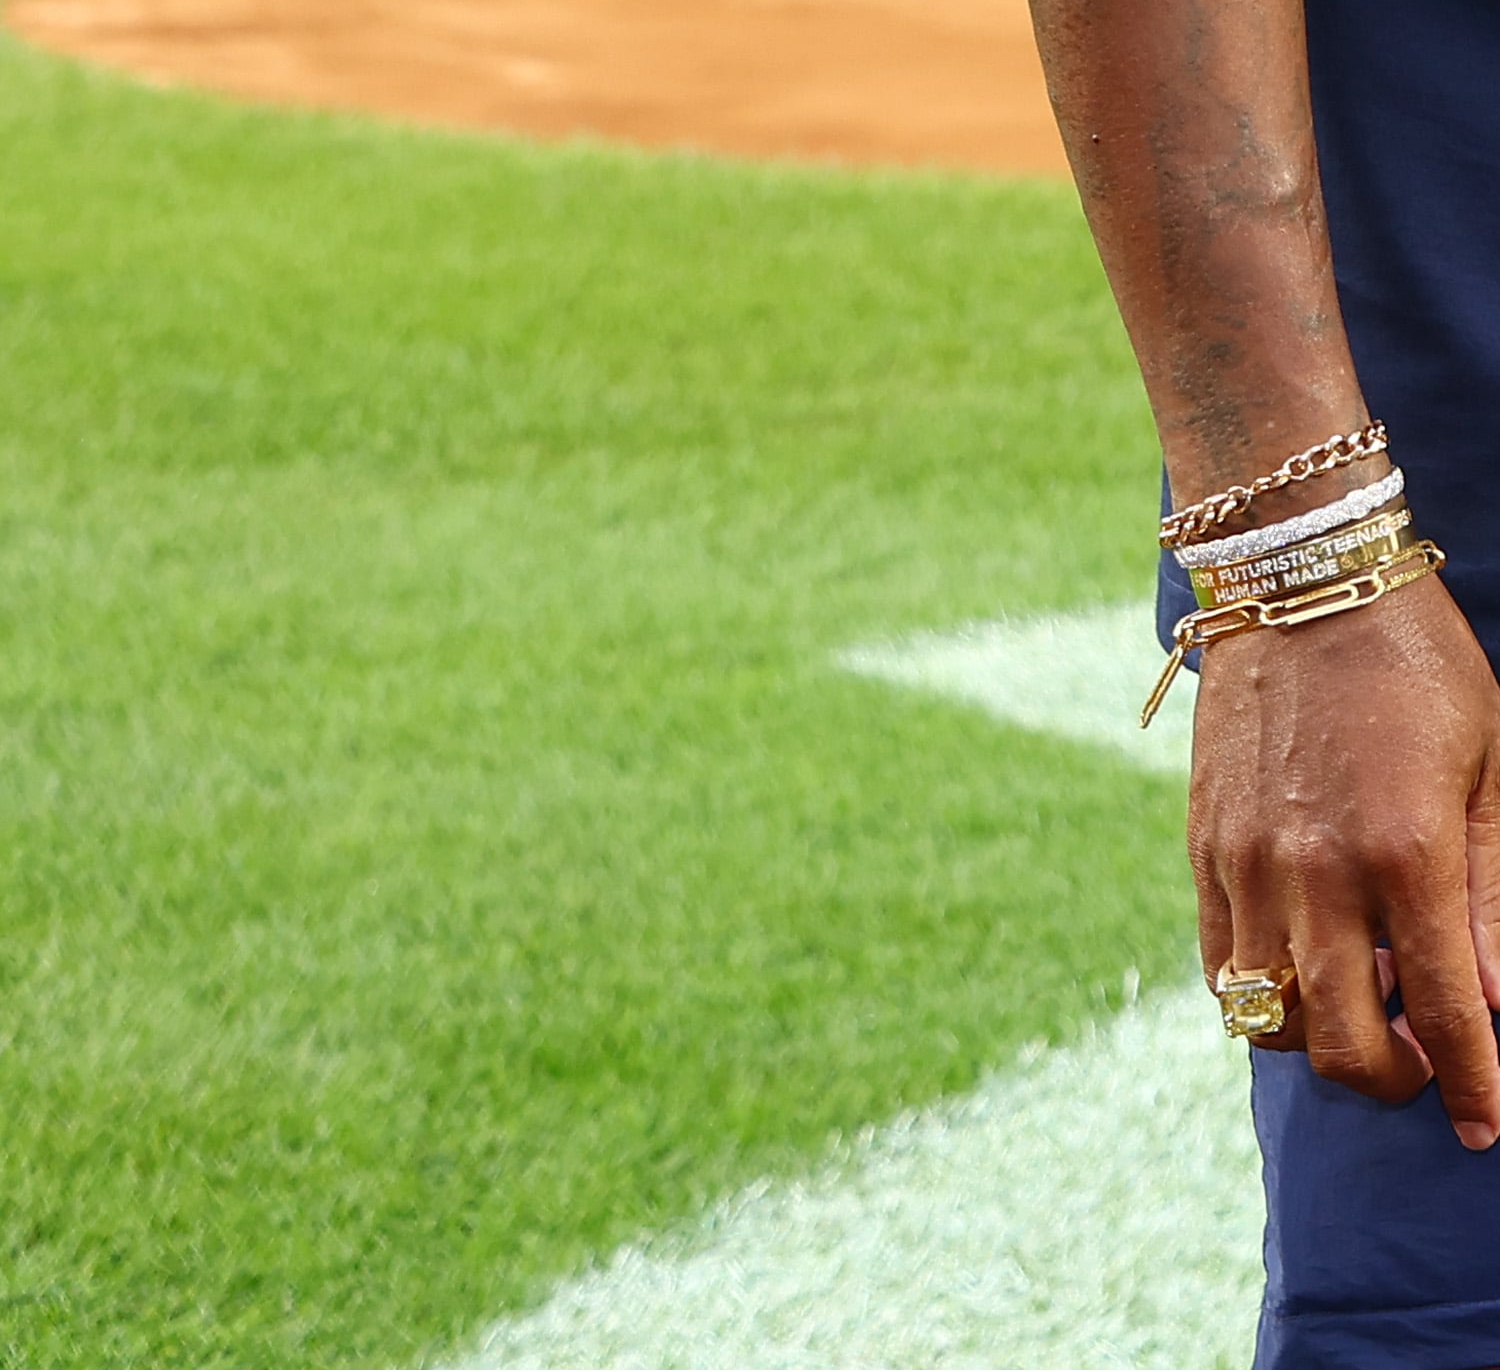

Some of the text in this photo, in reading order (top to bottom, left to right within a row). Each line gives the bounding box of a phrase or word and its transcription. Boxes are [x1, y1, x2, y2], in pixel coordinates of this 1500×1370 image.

[1214, 559, 1341, 604] HUMAN MADE
[1219, 547, 1319, 586] FUTURISTIC
